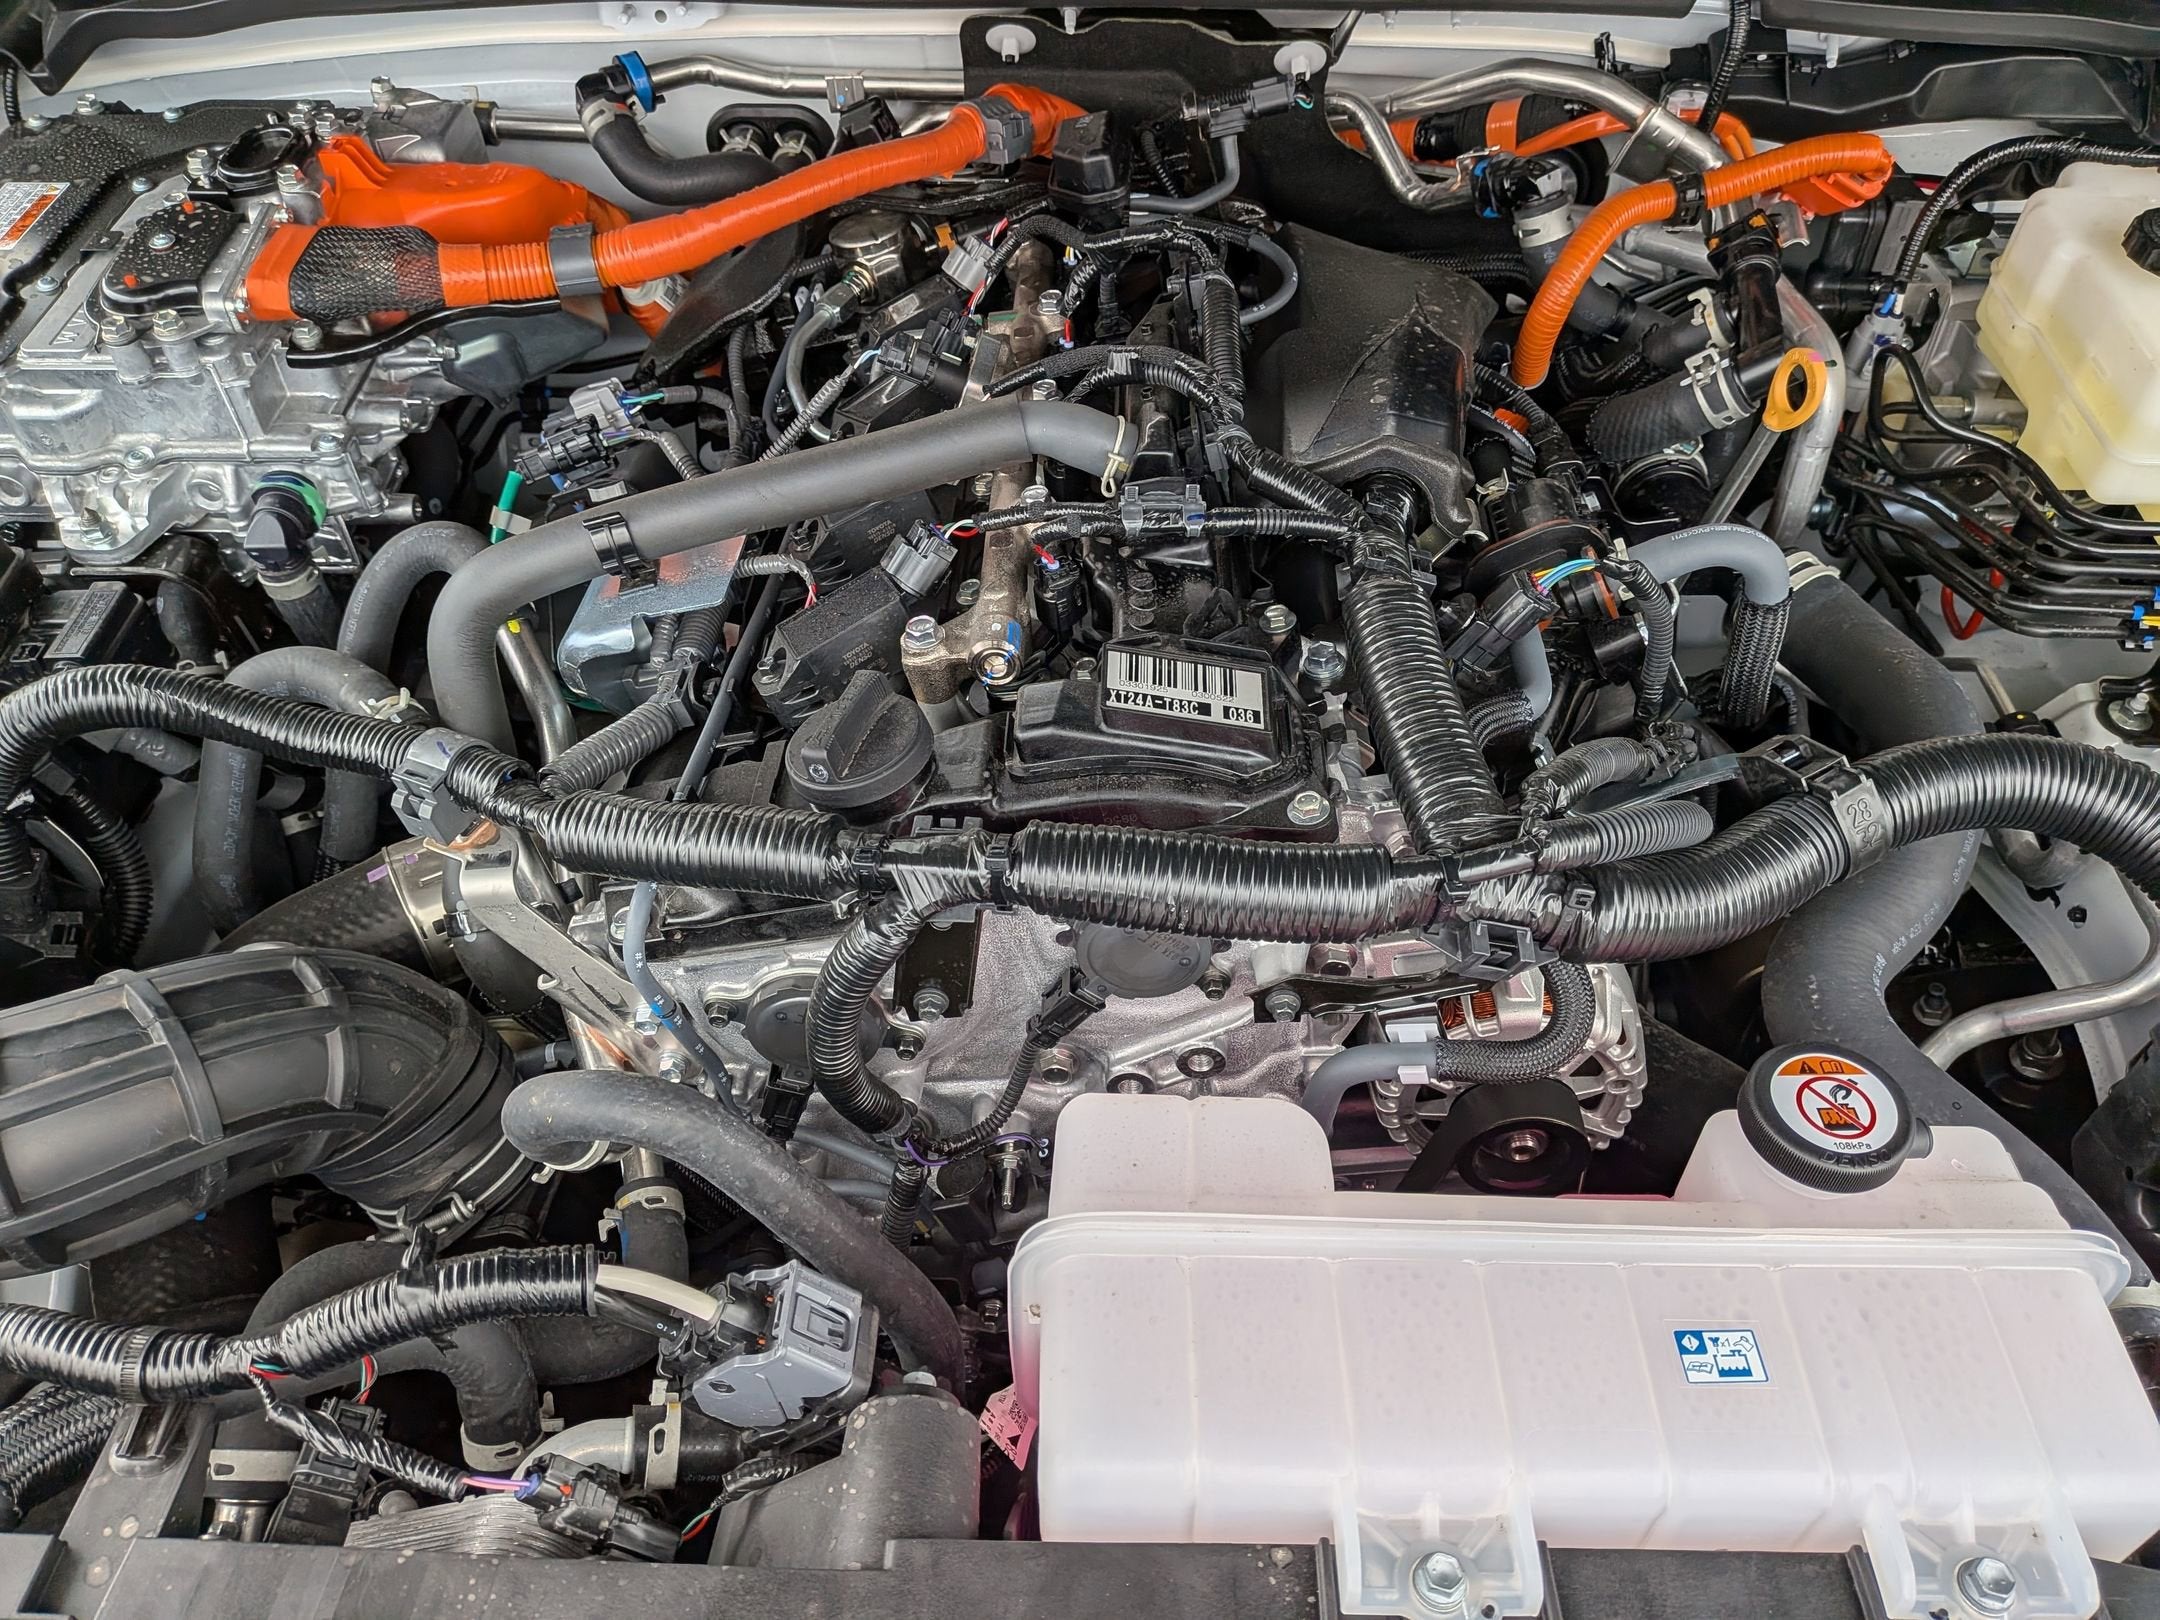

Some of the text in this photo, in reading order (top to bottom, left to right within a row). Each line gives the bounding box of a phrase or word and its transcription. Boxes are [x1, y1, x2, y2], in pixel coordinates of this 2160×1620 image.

[842, 642, 870, 660] TOYOTA
[849, 651, 873, 669] DENSO
[1108, 689, 1254, 724] XT24A-T83C 036
[1846, 797, 1872, 830] 28
[1855, 821, 1883, 853] 32
[1833, 1141, 1872, 1151] 108kPa
[1820, 1148, 1892, 1168] DENSO
